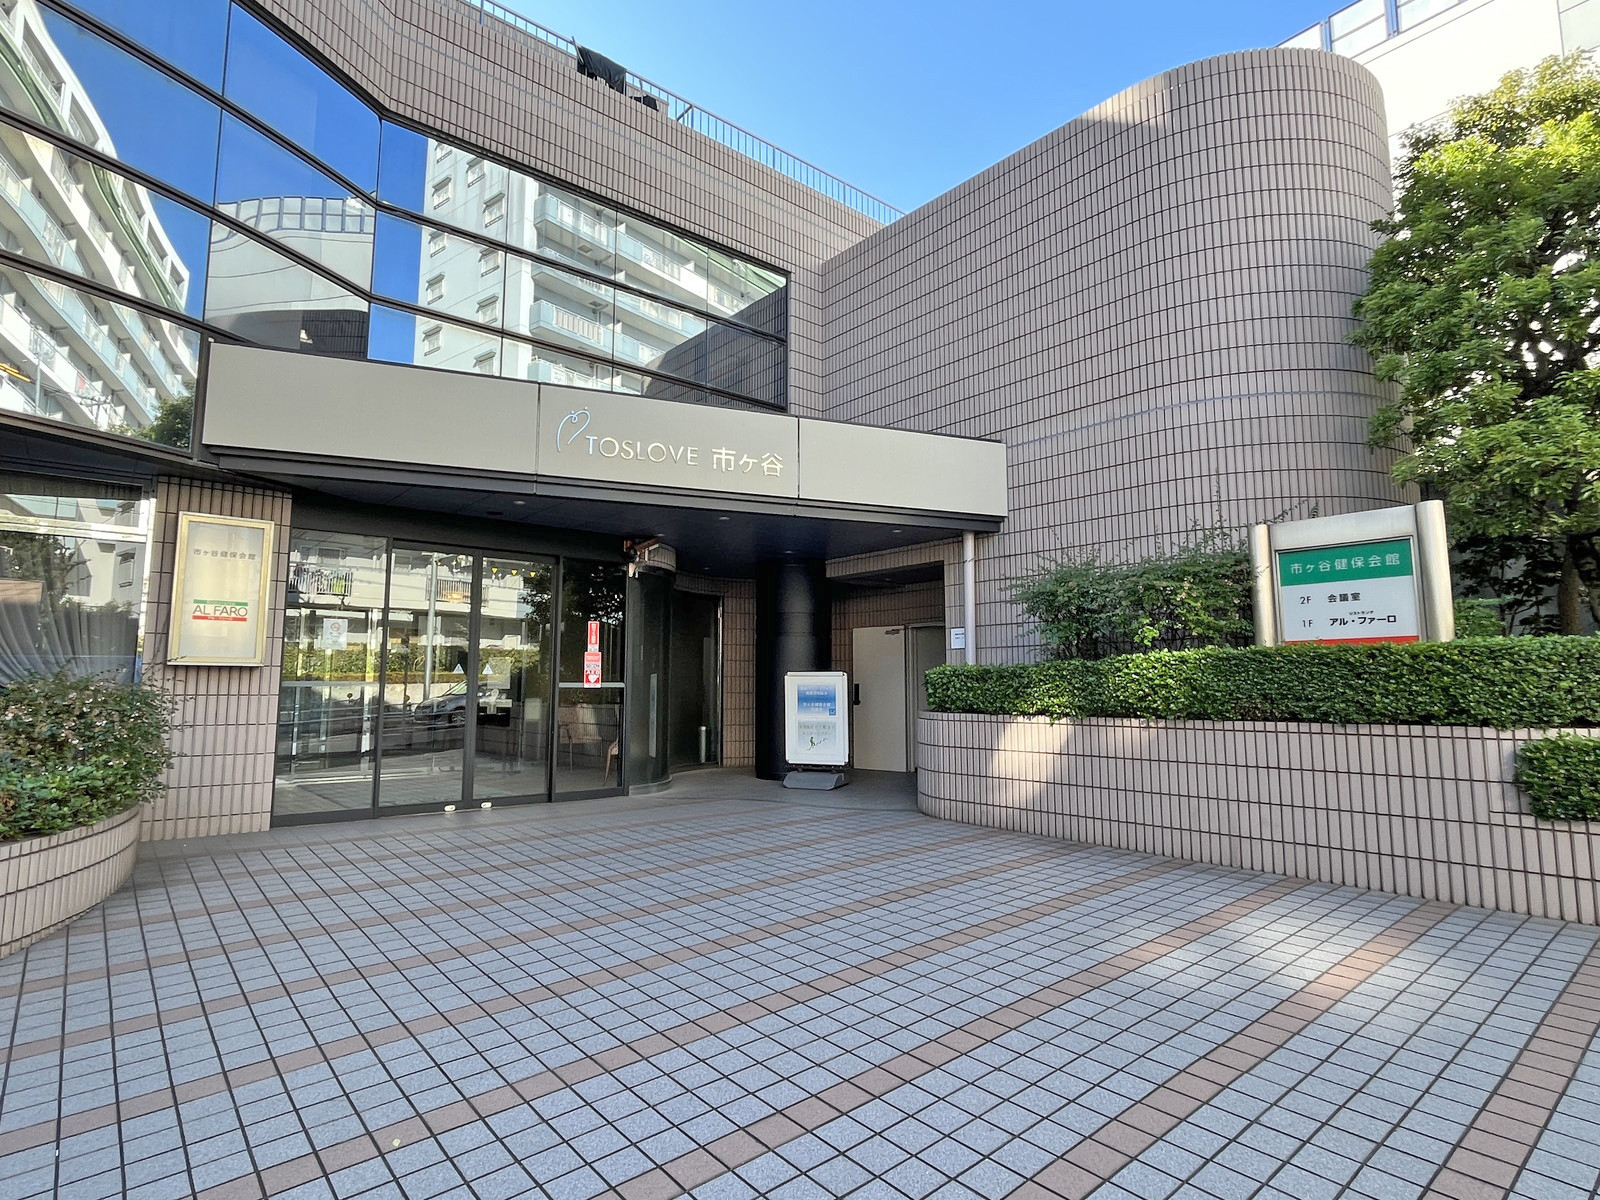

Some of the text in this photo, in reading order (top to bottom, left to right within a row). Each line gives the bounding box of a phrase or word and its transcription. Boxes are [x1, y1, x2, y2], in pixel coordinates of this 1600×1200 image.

[585, 435, 784, 478] TOSLOVE 市ヶ谷
[1290, 552, 1401, 574] 市ヶ谷健保会館
[1299, 592, 1361, 605] 2F 会議室
[192, 604, 248, 617] AL FARO
[1302, 614, 1397, 628] 1F アル・ファーロ
